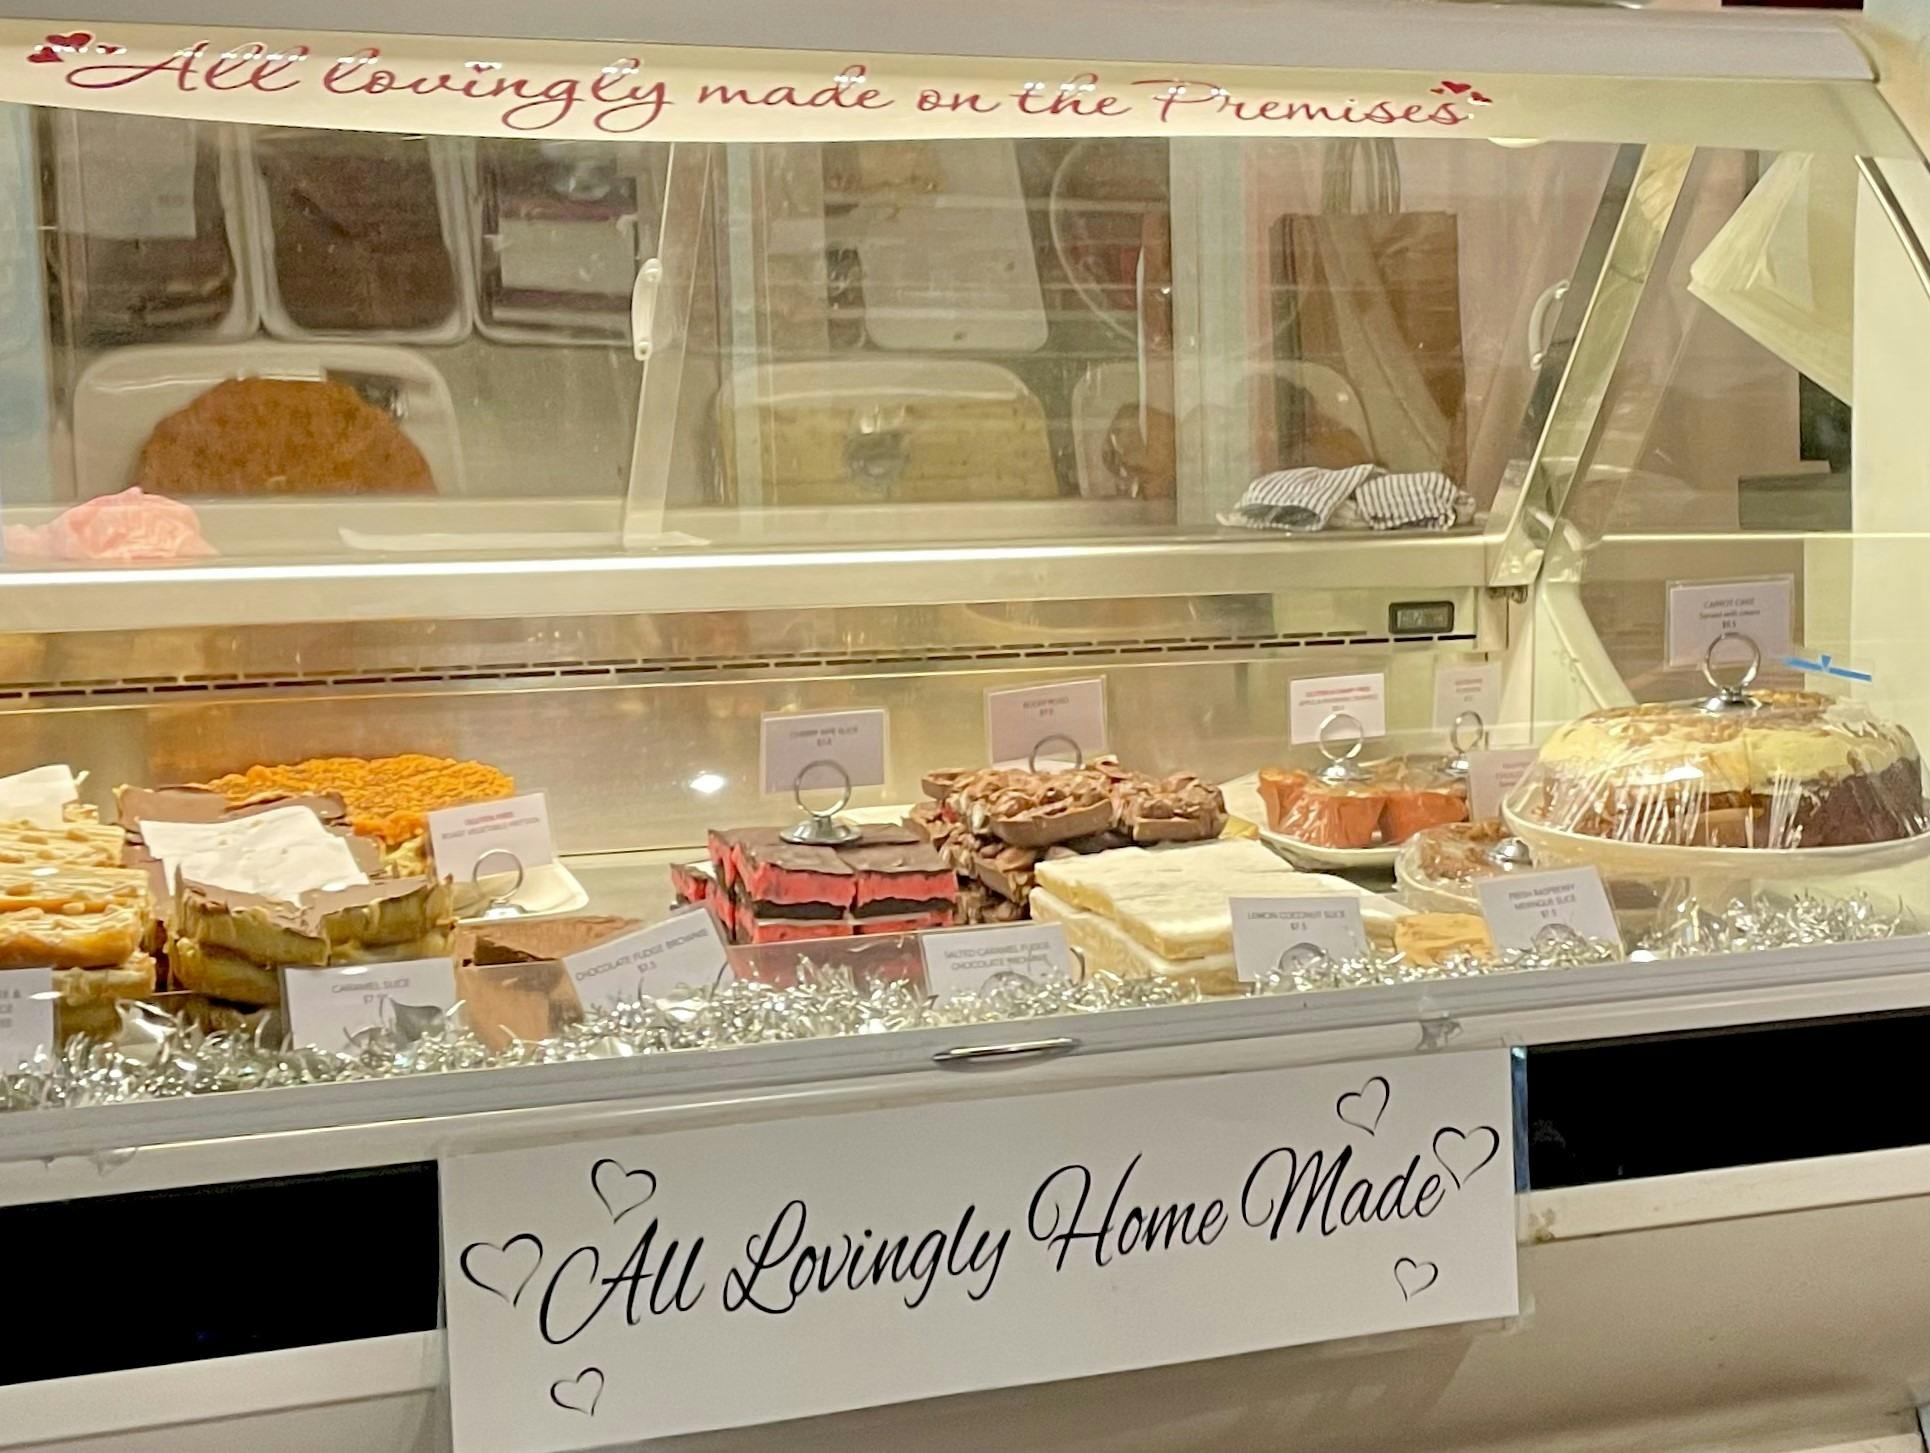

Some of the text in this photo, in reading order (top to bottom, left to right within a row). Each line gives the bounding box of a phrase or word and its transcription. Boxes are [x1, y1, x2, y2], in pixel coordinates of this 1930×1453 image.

[66, 40, 1471, 134] All lovingly made on the Premises
[1247, 911, 1278, 920] LEMON
[575, 953, 631, 982] CHOCOLATE
[632, 943, 665, 961] FUDGE
[943, 948, 976, 959] SALTED
[331, 978, 410, 994] CARAMEL SLICE
[539, 1144, 1446, 1345] All Lovingly Home Made
